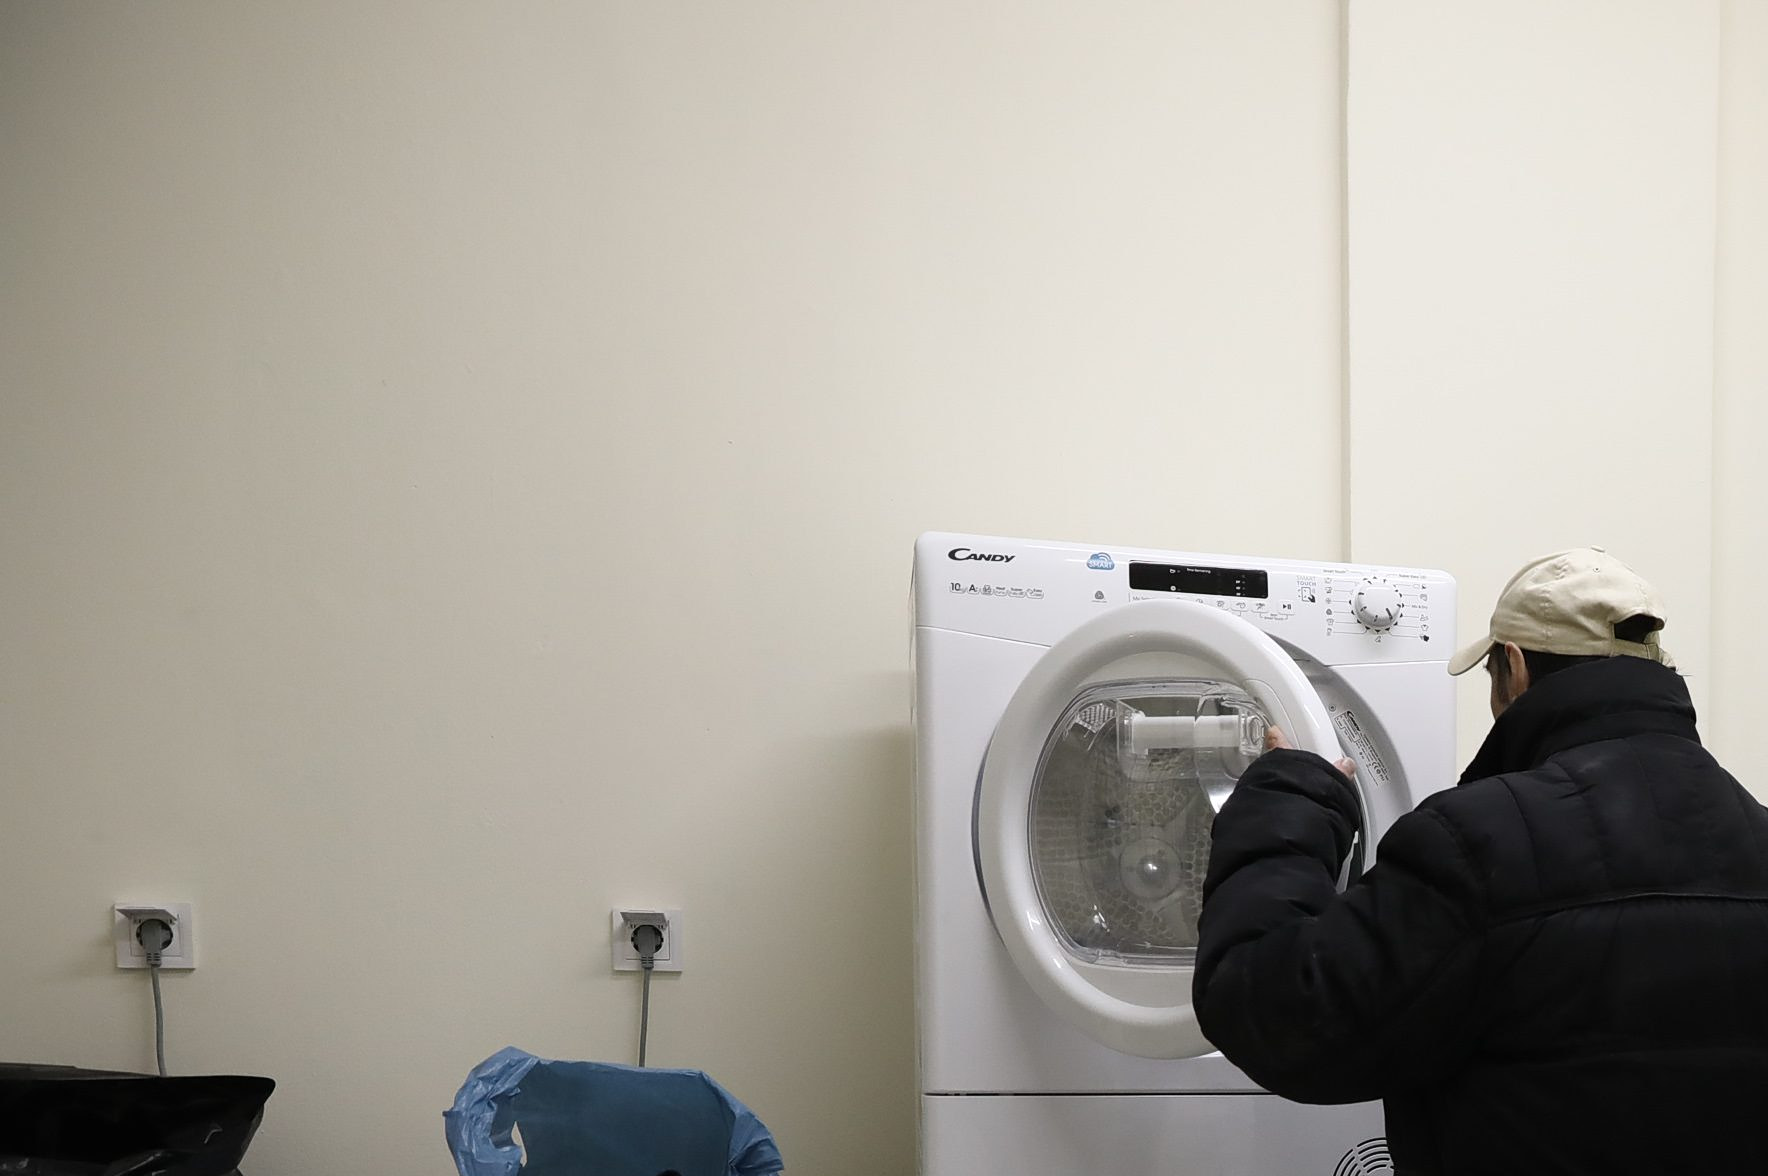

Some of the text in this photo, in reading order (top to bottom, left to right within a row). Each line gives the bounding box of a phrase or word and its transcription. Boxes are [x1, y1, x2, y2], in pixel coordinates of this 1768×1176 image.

[948, 548, 1016, 563] CANDY
[1088, 560, 1114, 568] SMART
[951, 583, 961, 591] 10
